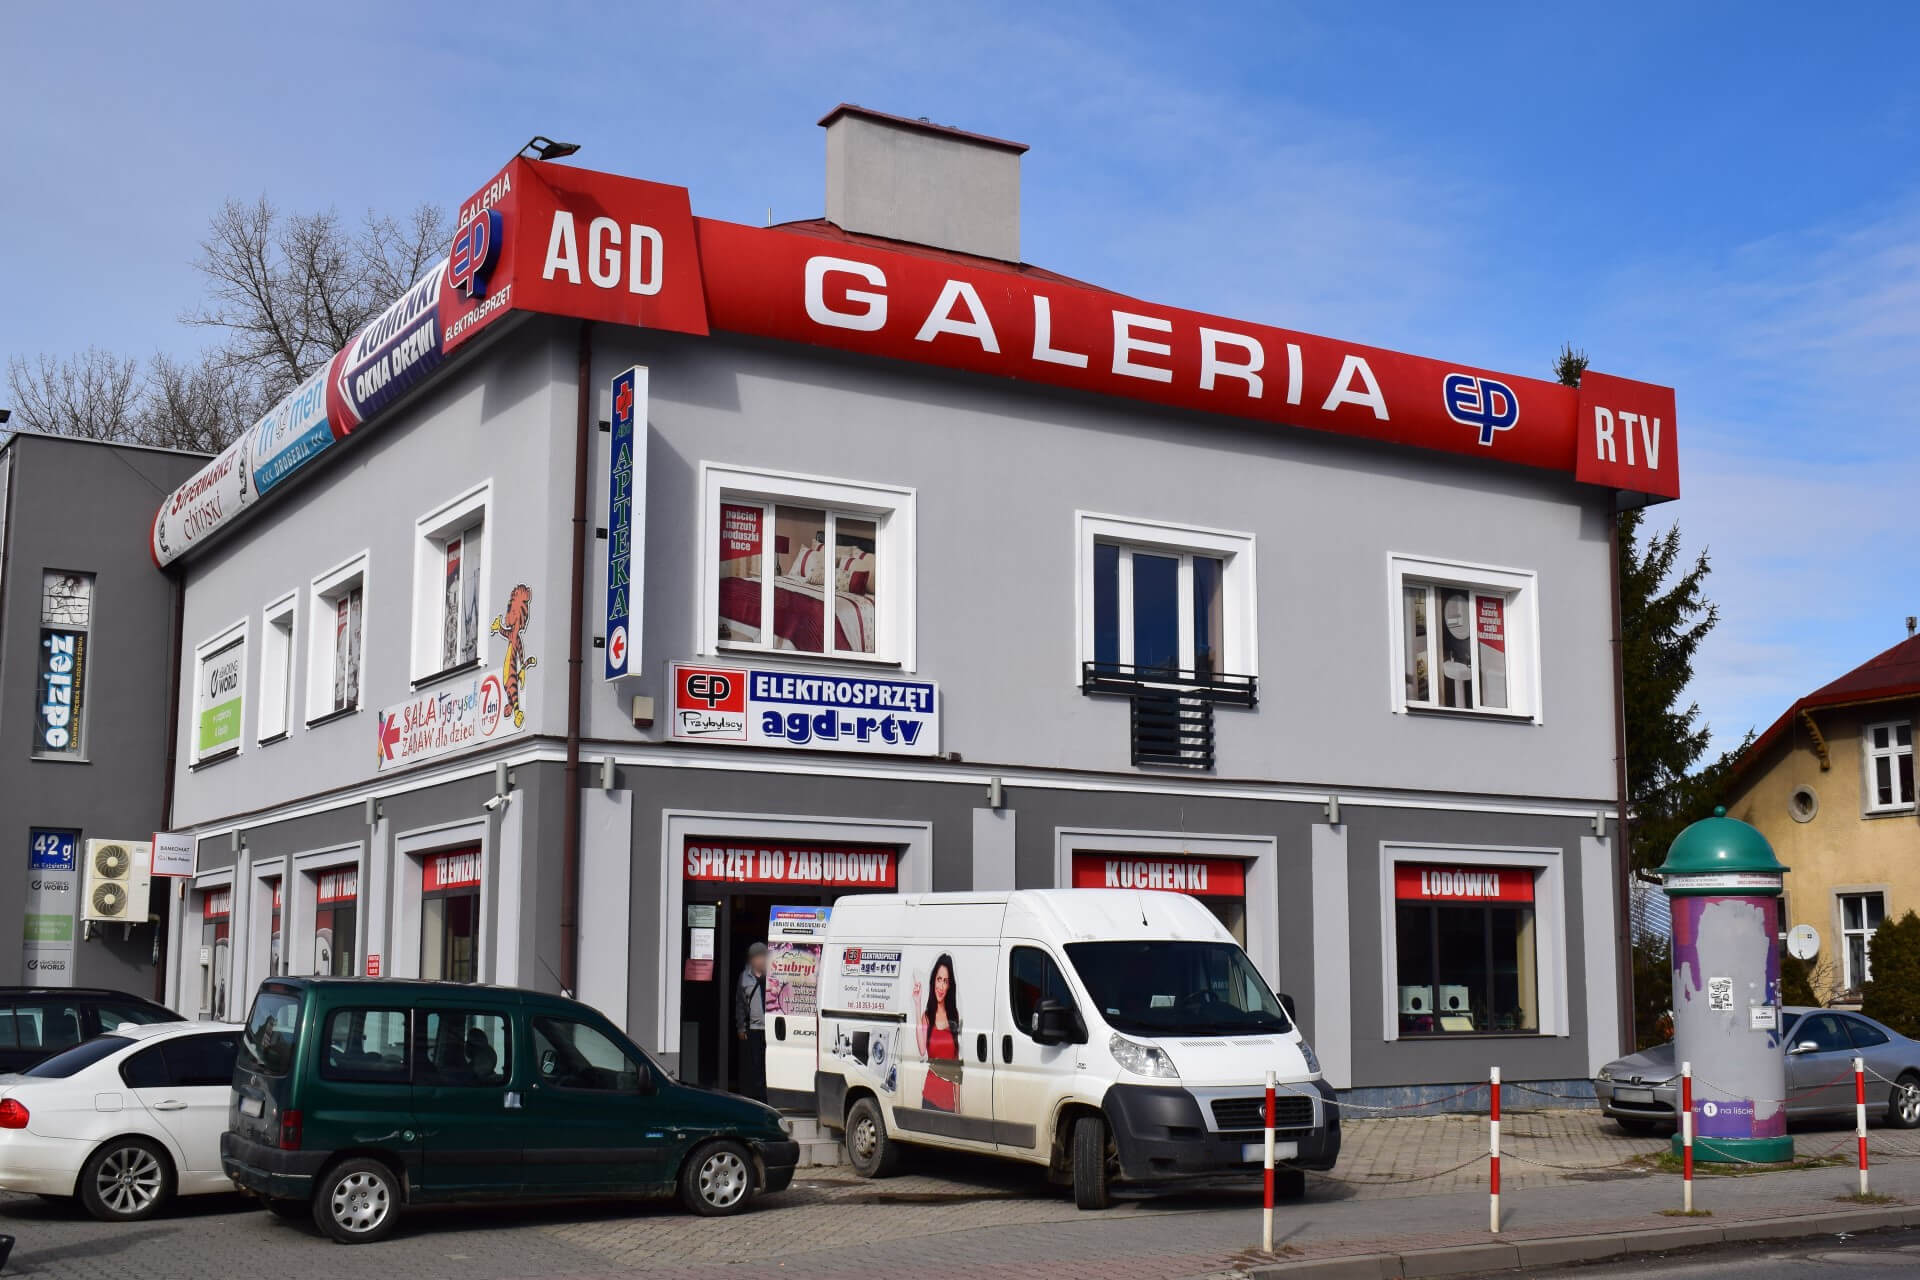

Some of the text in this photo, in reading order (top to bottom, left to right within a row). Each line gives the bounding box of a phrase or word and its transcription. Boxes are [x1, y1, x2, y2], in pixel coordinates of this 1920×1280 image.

[542, 210, 665, 297] AGD
[445, 284, 511, 341] ELEKTROSPRZĘT
[803, 254, 1391, 421] GALERIA
[356, 317, 437, 404] OKNA DRZWI
[1594, 404, 1661, 471] RTV
[273, 441, 310, 476] DROGERIA
[609, 443, 632, 620] APTEKA
[42, 633, 75, 748] odzież
[218, 672, 238, 695] WORLD
[480, 684, 492, 715] 7
[755, 675, 930, 712] ELEKTROSPRZĘT
[487, 699, 498, 713] dni
[679, 711, 743, 732] Przybylscy
[761, 708, 924, 746] agd-rtv
[34, 835, 72, 861] 42 g
[687, 846, 889, 883] SPRZĘT DO ZABUDOWY
[1105, 860, 1209, 891] KUCHENKI
[1421, 869, 1500, 898] LODÓWKI
[1733, 1106, 1754, 1115] liście
